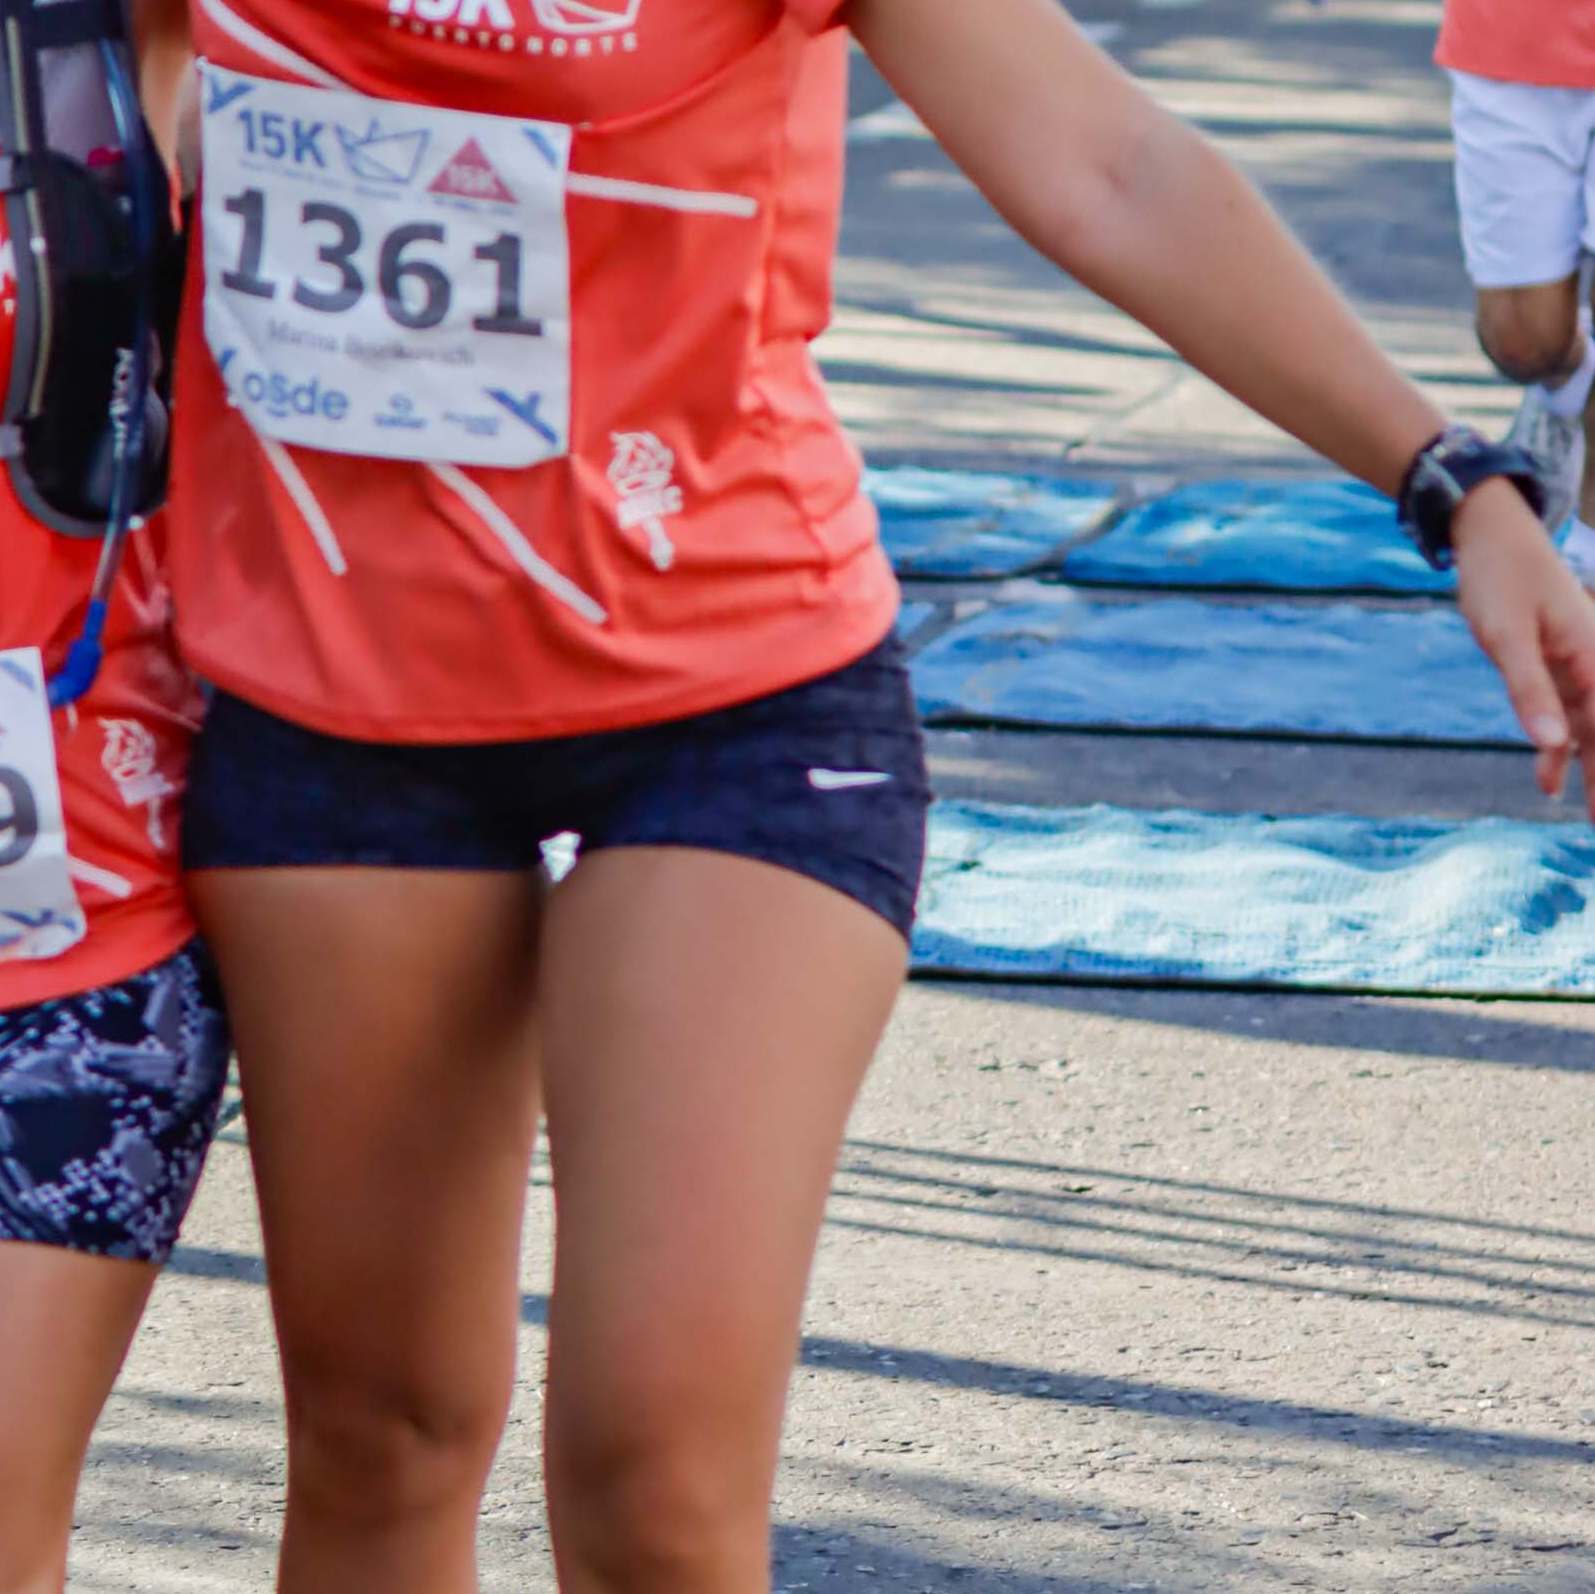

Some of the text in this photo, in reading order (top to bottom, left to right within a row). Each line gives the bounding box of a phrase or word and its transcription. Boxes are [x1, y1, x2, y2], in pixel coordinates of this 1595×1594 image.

[388, 15, 640, 58] PUERTO NORTE
[237, 108, 327, 169] 15K
[220, 185, 544, 338] 1361
[243, 371, 349, 421] osde
